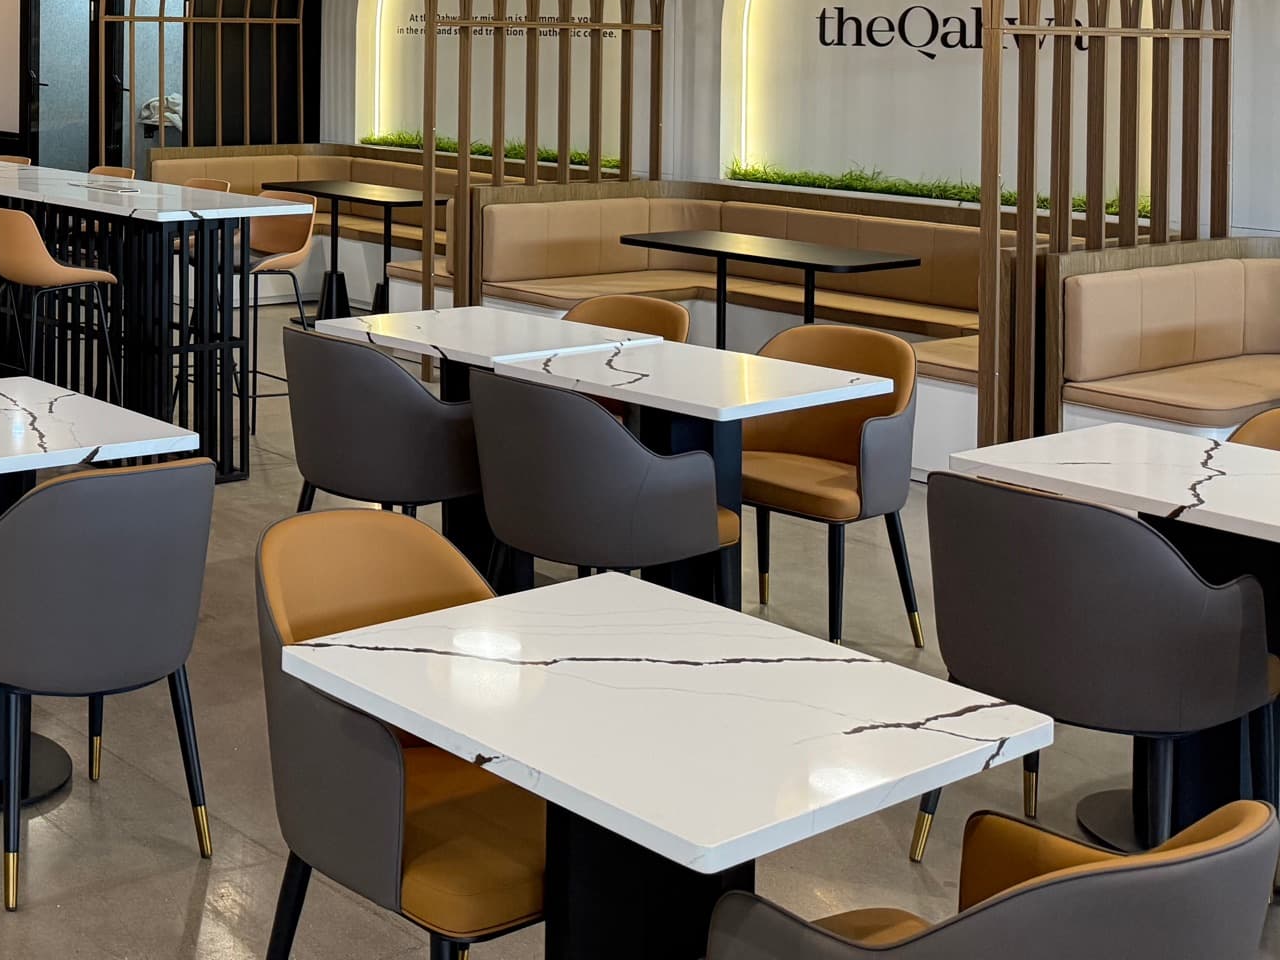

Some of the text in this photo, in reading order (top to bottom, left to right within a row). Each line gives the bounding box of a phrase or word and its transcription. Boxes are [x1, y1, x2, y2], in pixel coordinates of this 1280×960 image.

[409, 13, 418, 22] At
[396, 25, 404, 34] in
[406, 25, 418, 34] the
[436, 26, 452, 35] and
